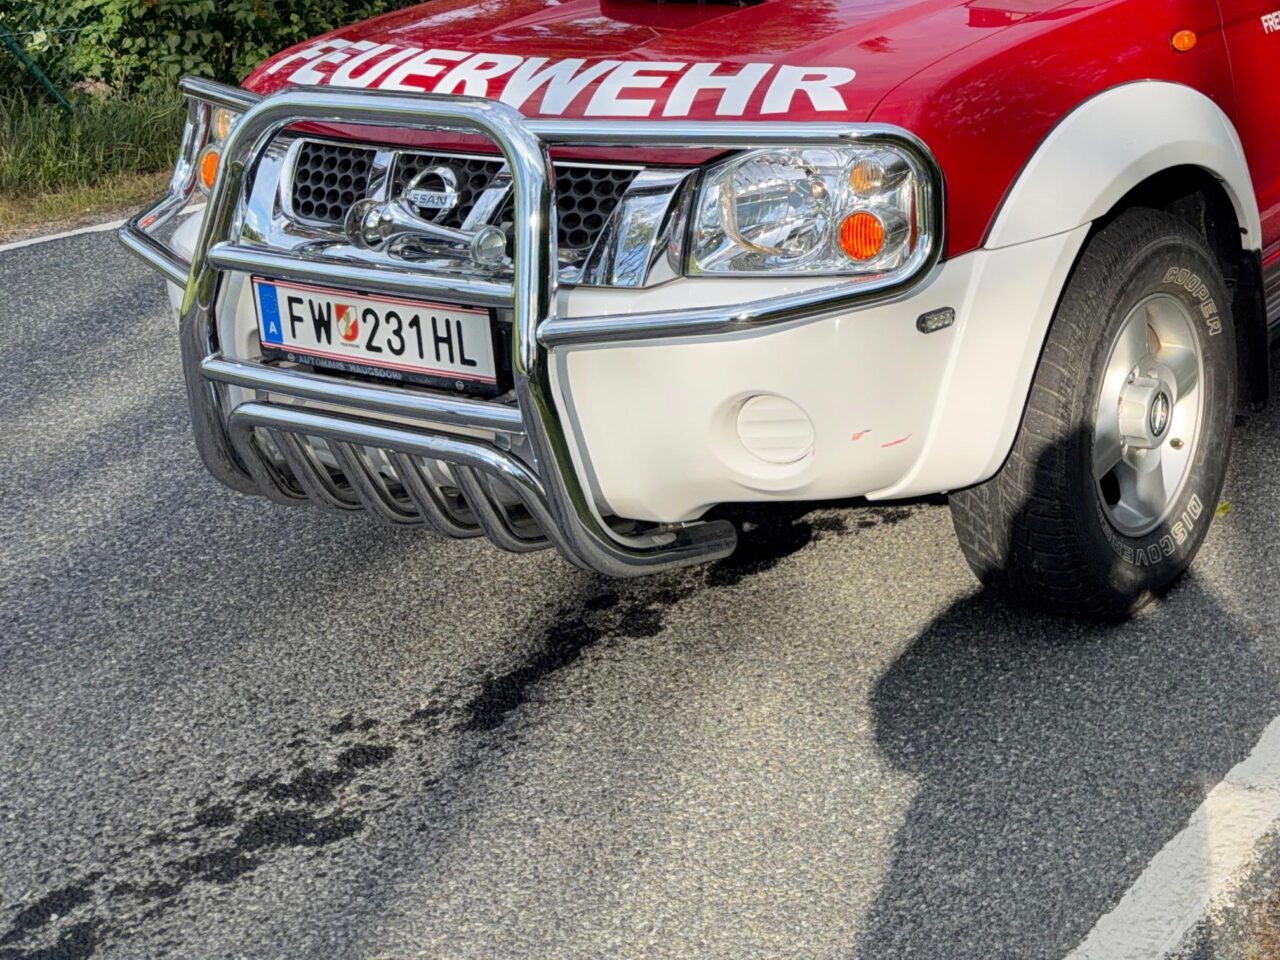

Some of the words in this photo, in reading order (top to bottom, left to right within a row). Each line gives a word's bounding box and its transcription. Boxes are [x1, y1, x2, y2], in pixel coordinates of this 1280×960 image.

[265, 38, 857, 117] FEUERWEHR
[269, 321, 278, 335] A
[286, 295, 332, 346] FW
[361, 307, 478, 367] 231HL
[1163, 266, 1222, 336] COOPER
[298, 355, 345, 371] AUTOHAUS
